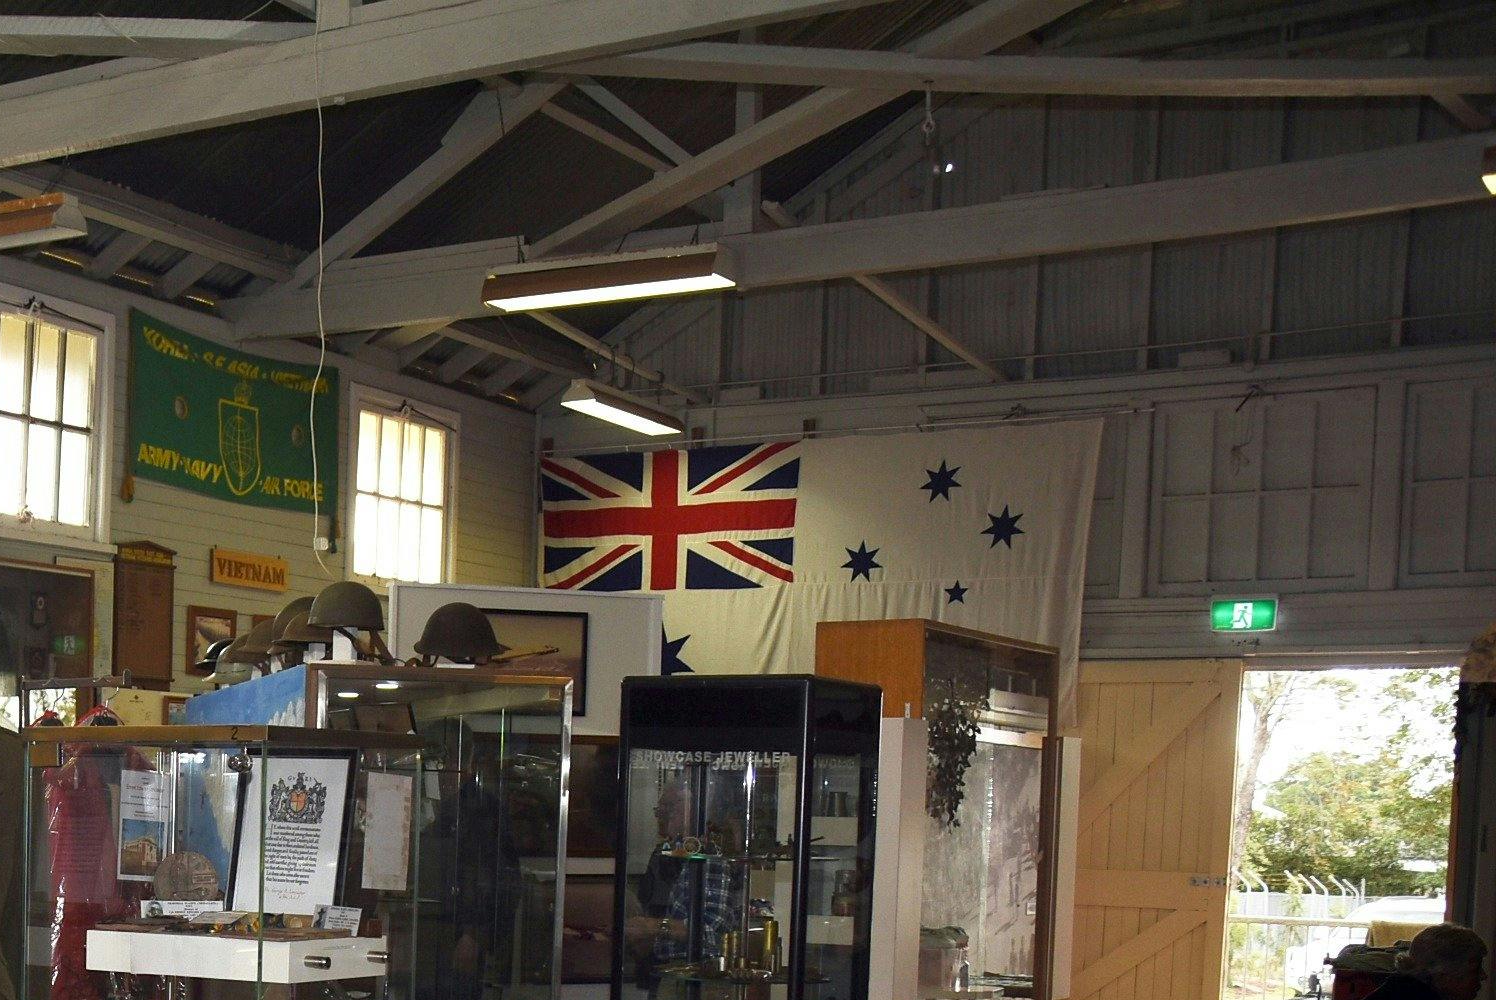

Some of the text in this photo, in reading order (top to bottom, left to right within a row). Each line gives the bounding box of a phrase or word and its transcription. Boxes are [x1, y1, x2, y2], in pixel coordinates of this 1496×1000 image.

[216, 557, 285, 586] VIETNAM
[231, 726, 239, 740] 2
[637, 750, 791, 763] SHOWCASE JEWELLER
